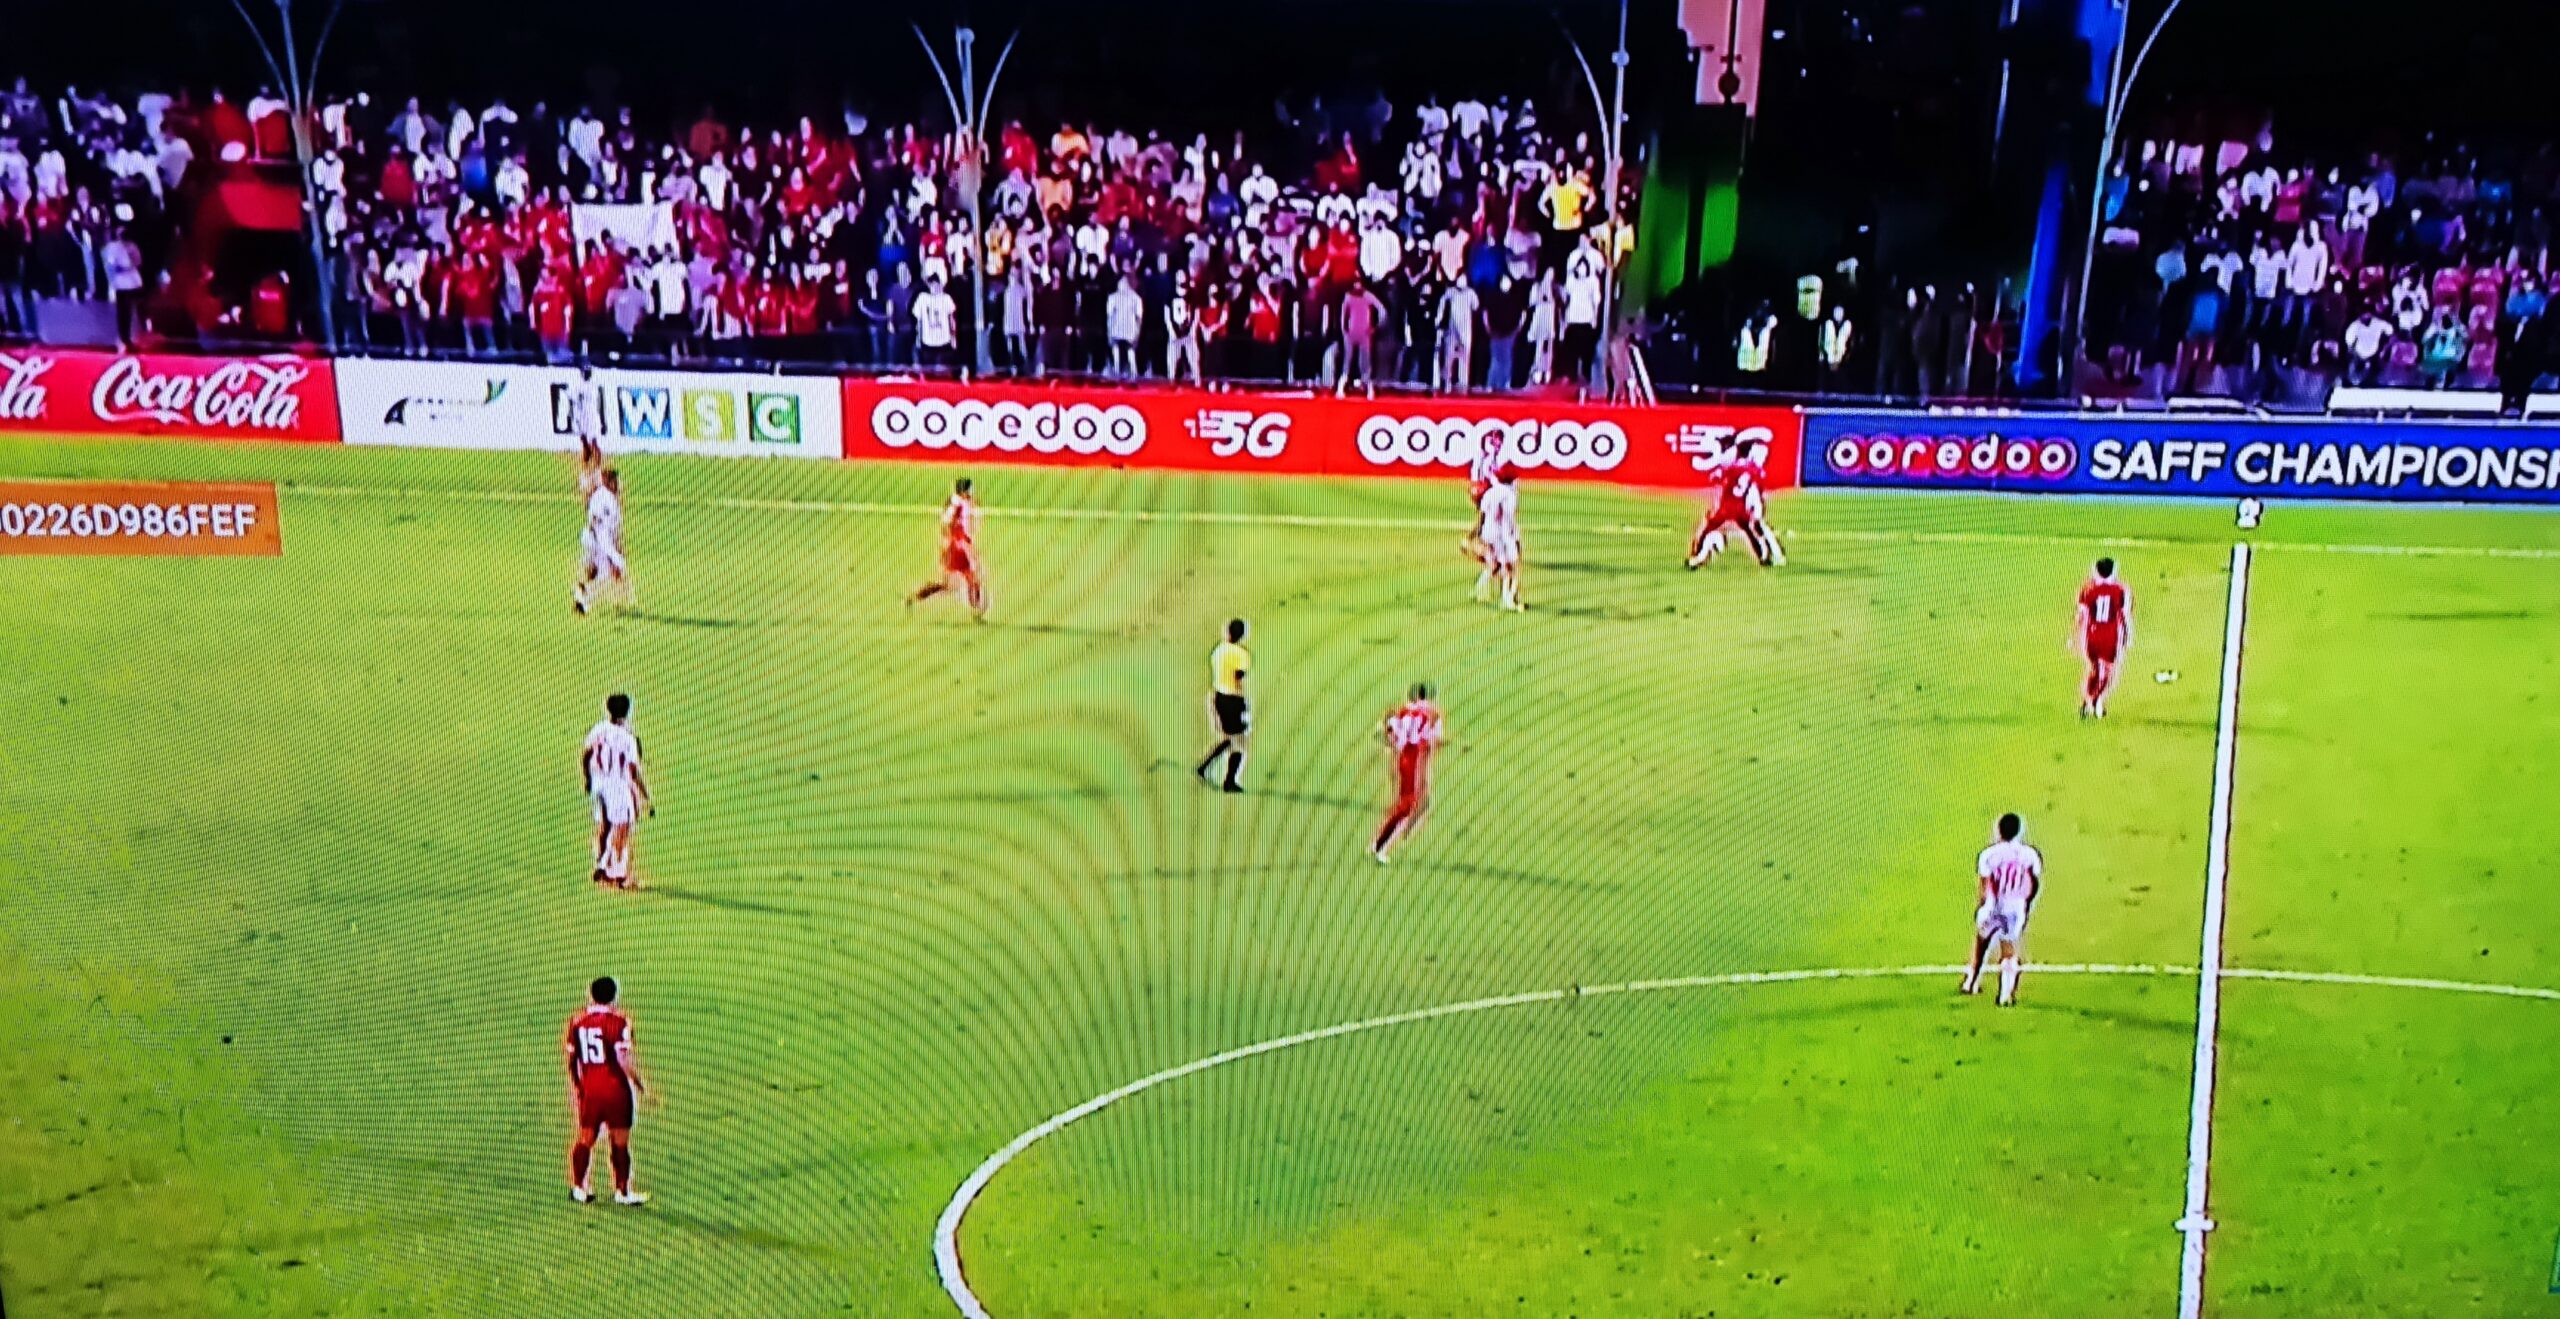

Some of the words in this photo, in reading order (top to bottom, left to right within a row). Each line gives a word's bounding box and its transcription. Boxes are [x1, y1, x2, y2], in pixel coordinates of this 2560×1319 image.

[92, 355, 308, 429] Coca-Cola
[883, 401, 1137, 444] ooredoo
[1198, 409, 1291, 457] 5G
[1830, 432, 2071, 475] ooredoo
[2089, 439, 2227, 482] SAFF
[0, 502, 257, 538] 0226D986FEF
[578, 1026, 605, 1064] 15
